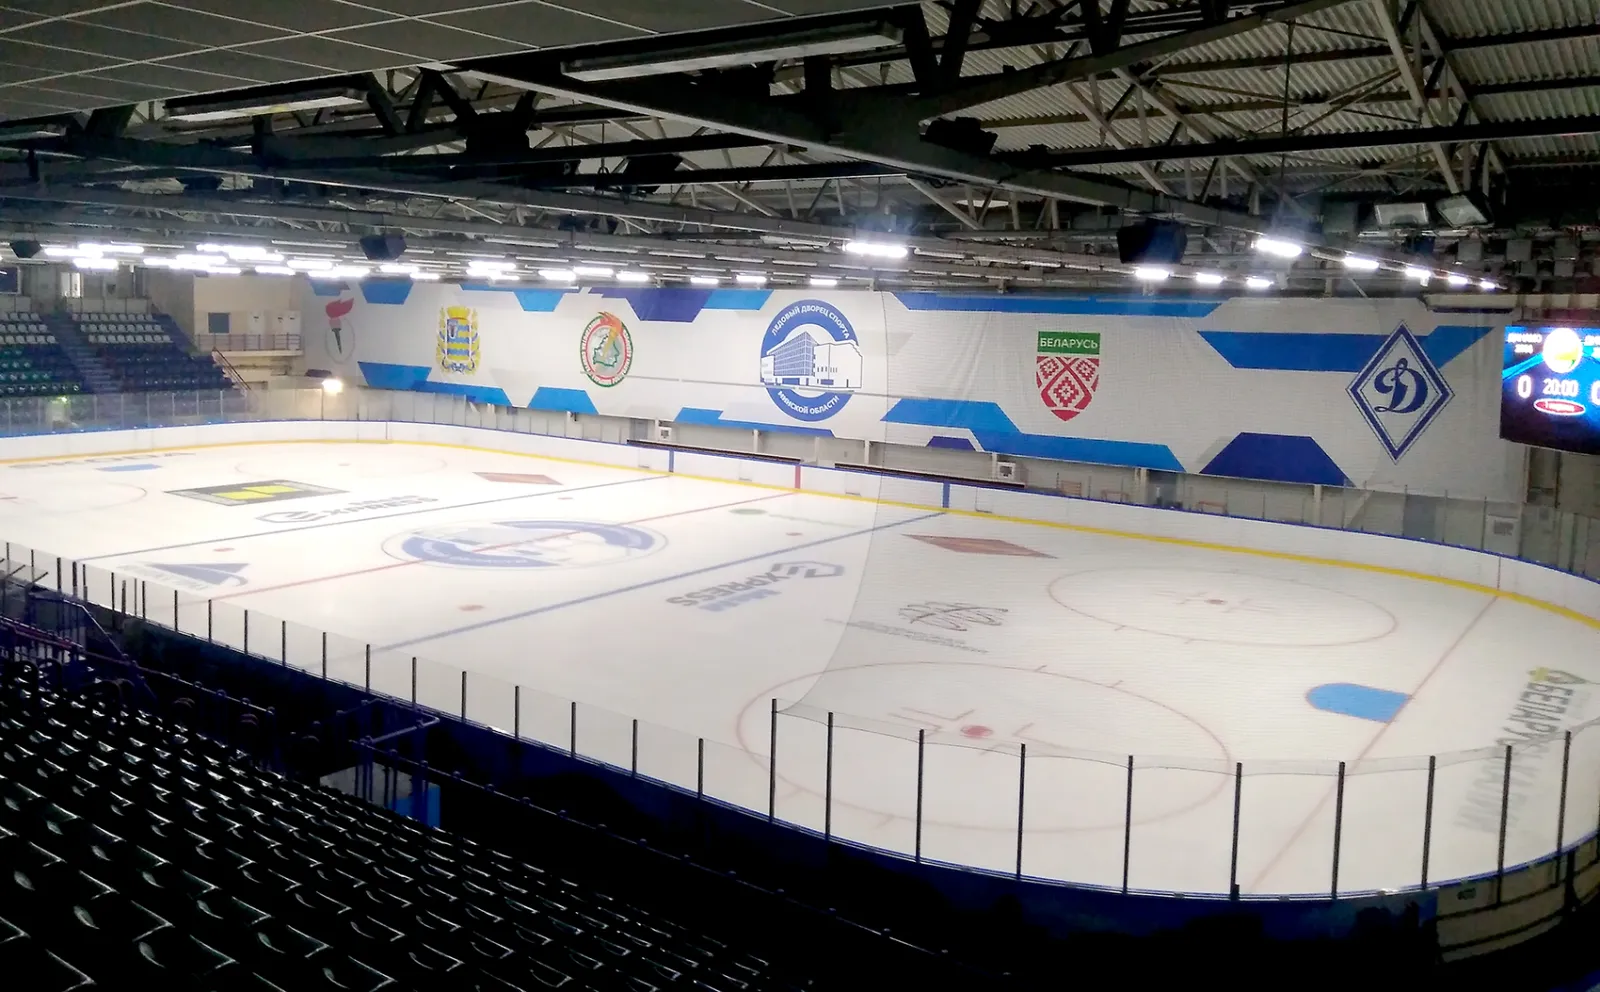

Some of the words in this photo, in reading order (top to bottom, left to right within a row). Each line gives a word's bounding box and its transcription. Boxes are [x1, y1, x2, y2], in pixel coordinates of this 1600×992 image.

[771, 306, 801, 336] ЛЕДОВЫЙ
[801, 305, 829, 317] ДВОРЕЦ
[828, 312, 850, 339] СПОРТА
[1039, 337, 1098, 349] БЕЛАРУСЬ
[1517, 374, 1532, 399] 0
[1542, 378, 1579, 397] 20:00
[777, 392, 808, 415] МИНСКОЙ
[809, 394, 840, 415] ОБЛАСТИ
